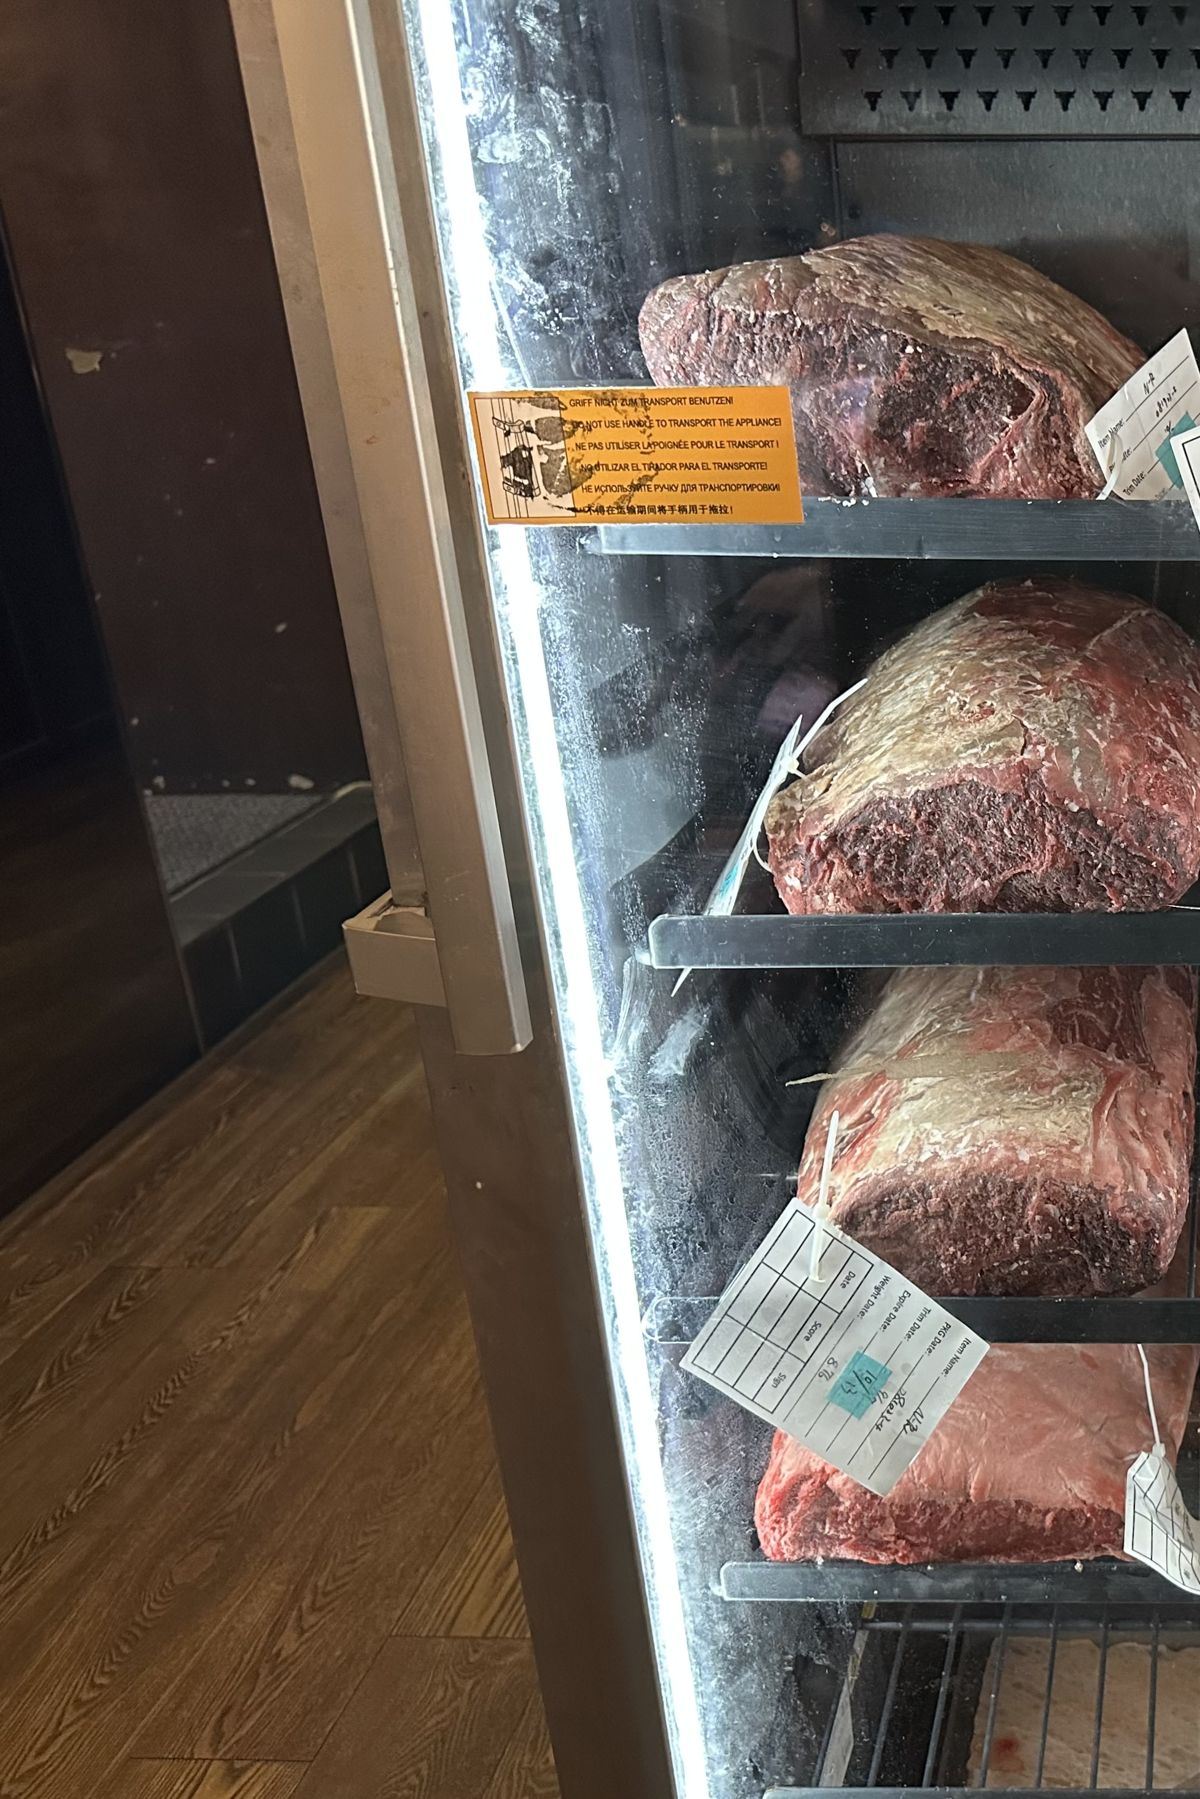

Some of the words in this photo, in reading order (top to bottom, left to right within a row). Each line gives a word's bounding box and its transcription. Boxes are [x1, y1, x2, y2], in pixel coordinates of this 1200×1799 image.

[569, 398, 592, 407] GRIFF
[638, 396, 687, 407] TRANSPORT
[604, 419, 621, 429] USE
[656, 418, 667, 428] TO
[668, 418, 716, 427] TRANSPORT
[719, 417, 734, 426] THE
[575, 442, 586, 450] NE
[588, 442, 603, 450] PAS
[691, 440, 714, 449] POUR
[715, 440, 726, 449] LE
[727, 439, 775, 449] TRANSPORT
[631, 463, 640, 471] EL
[679, 462, 701, 471] PARA
[702, 462, 711, 470] EL
[581, 485, 593, 493] НЕ
[654, 484, 679, 493] РУЧКУ
[681, 484, 697, 494] ДЛЯ
[839, 1270, 855, 1289] Date
[868, 1273, 890, 1300] Weight
[857, 1297, 874, 1319] Date:
[889, 1288, 910, 1313] Expire
[879, 1310, 896, 1332] Date:
[915, 1306, 930, 1323] Trim
[803, 1320, 821, 1342] Score
[903, 1320, 920, 1341] Date:
[937, 1322, 950, 1337] PKG
[924, 1334, 942, 1355] Date:
[955, 1337, 970, 1355] Item
[940, 1353, 960, 1377] Name:
[770, 1372, 786, 1389] Sign
